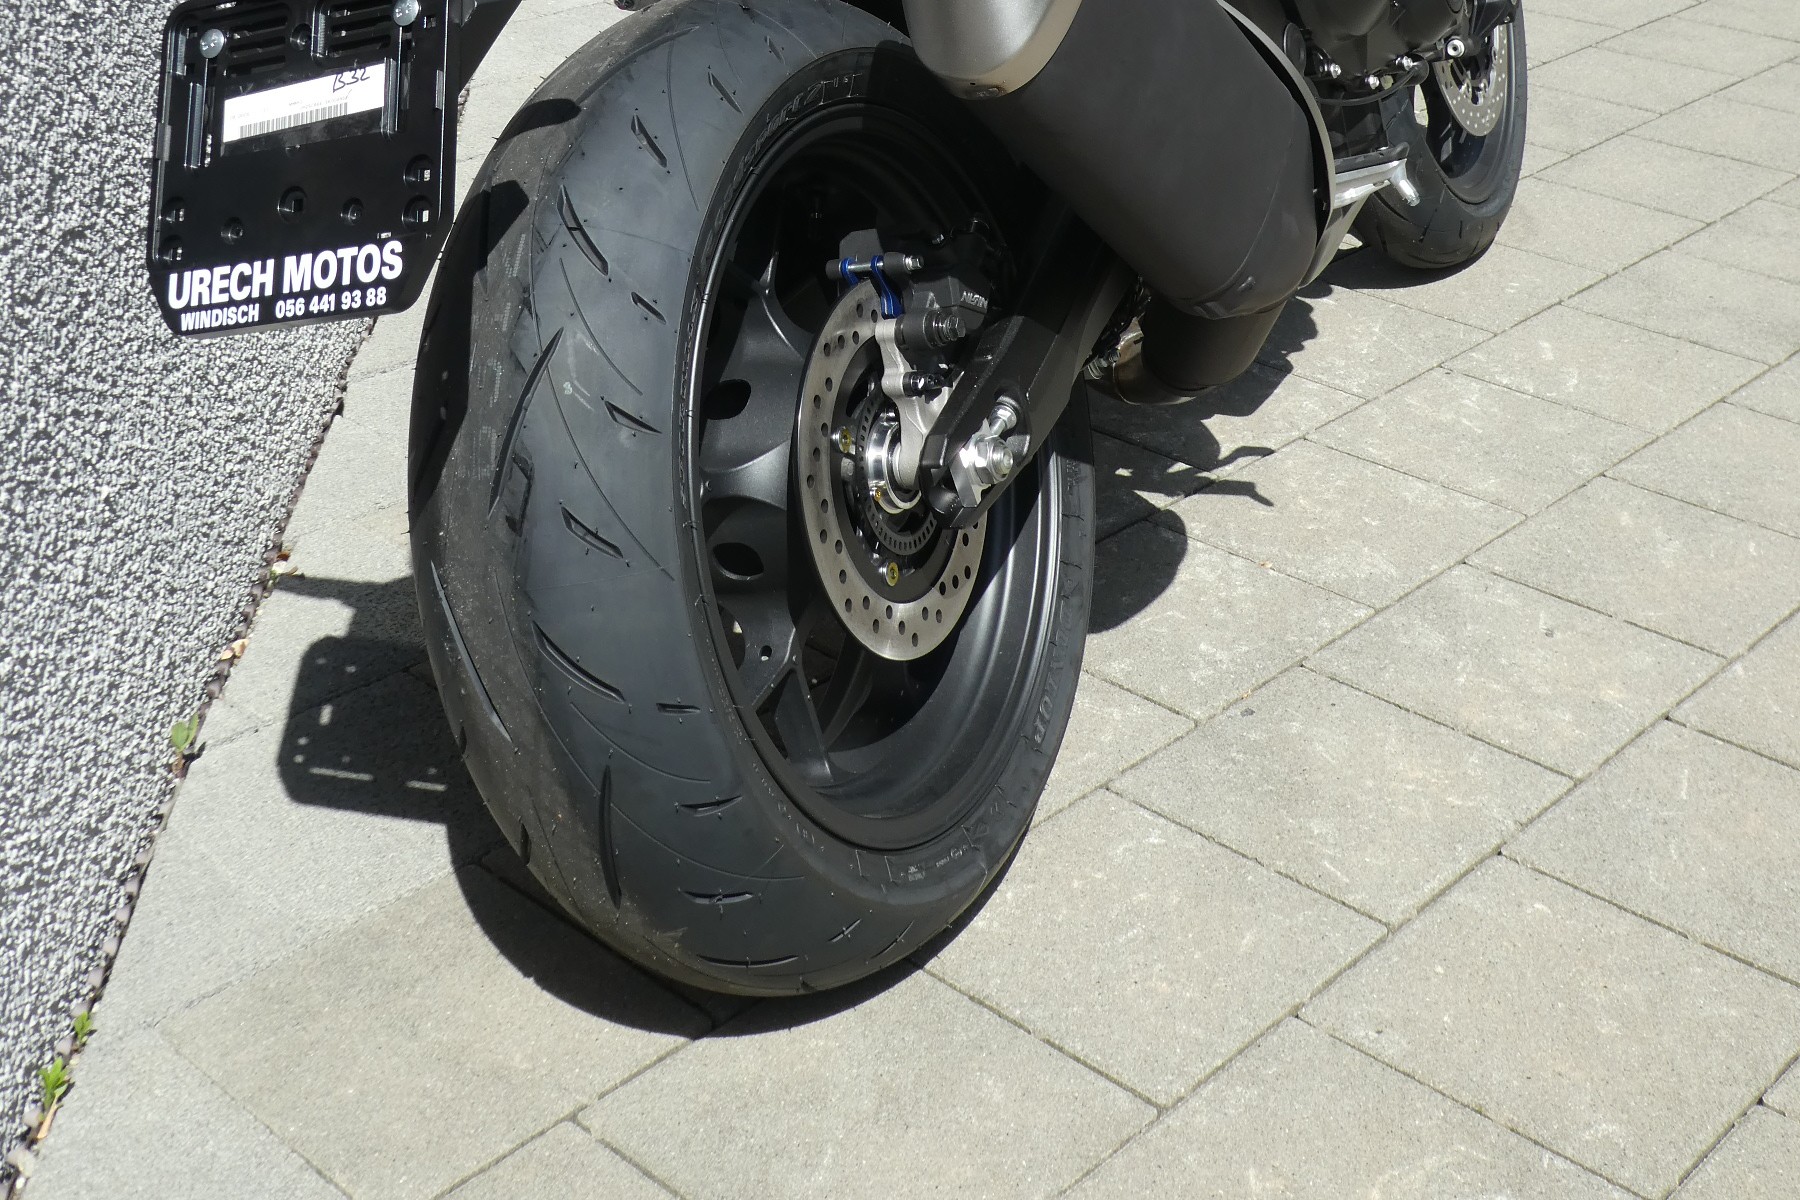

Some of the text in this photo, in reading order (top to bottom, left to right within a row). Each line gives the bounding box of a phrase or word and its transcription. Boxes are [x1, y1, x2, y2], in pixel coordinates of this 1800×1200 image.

[167, 240, 403, 309] URECH MOTOS
[180, 286, 387, 331] WINDISCH 056 441 93 88
